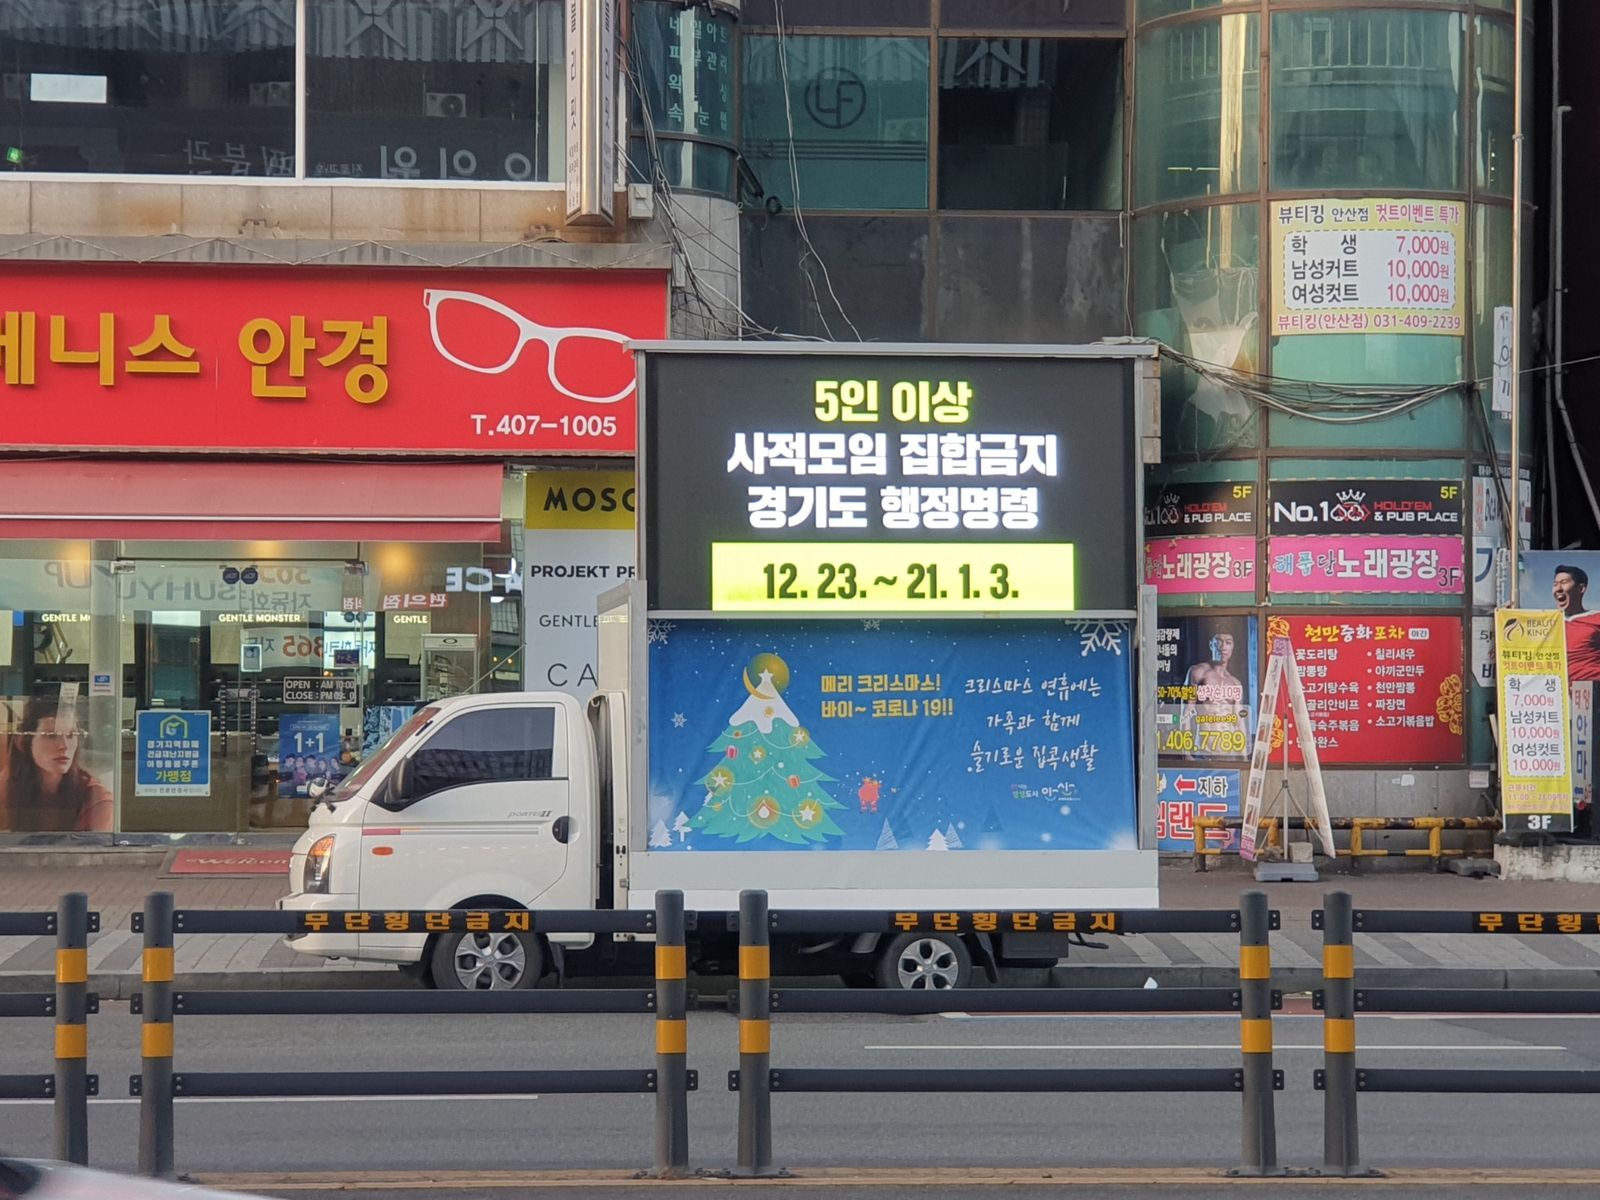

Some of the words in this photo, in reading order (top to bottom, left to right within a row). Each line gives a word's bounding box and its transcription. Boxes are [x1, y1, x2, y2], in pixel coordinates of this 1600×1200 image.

[1279, 204, 1325, 224] 뷰티킹
[1331, 207, 1369, 223] 안산점
[1439, 205, 1460, 225] 특가
[1291, 236, 1308, 256] 학
[1341, 234, 1357, 255] 생
[1396, 236, 1449, 256] 7,000원
[1292, 258, 1359, 279] 남성커트
[1387, 259, 1449, 280] 10,000원
[1387, 284, 1449, 304] 10,000원
[1278, 314, 1369, 330] 뷰티킹(안산점)
[1373, 315, 1461, 330] 031-409-2239
[238, 315, 389, 404] 안경
[815, 380, 879, 422] 5인
[892, 381, 972, 423] 이상
[470, 414, 617, 437] T.407-1005
[727, 431, 887, 475] 사적모임
[899, 432, 1057, 476] 집합금지
[1233, 485, 1252, 499] 5F
[1440, 486, 1457, 499] 5F
[747, 486, 868, 528] 경기도
[880, 485, 1039, 529] 행정명령
[1192, 513, 1213, 523] PUB
[1215, 512, 1251, 522] PLACE
[1386, 511, 1415, 521] PUB
[1417, 511, 1458, 522] PLACE
[531, 565, 609, 578] PROJEKT
[1162, 552, 1231, 579] 노래광장
[1233, 560, 1254, 578] 3F
[1336, 549, 1439, 579] 노래광장
[1438, 567, 1462, 588] 3F
[763, 563, 808, 599] 12.
[817, 563, 867, 599] 23.
[907, 563, 947, 599] 21.
[959, 563, 980, 599] 1.
[990, 563, 1019, 599] 3.
[218, 613, 255, 623] GENTLE
[256, 613, 301, 623] MONSTER
[393, 614, 428, 624] GENTLE
[1375, 648, 1416, 660] 칠리새우
[1502, 650, 1532, 661] 뷰티킹
[1375, 665, 1425, 677] 야끼군만두
[286, 680, 311, 689] OPEN
[857, 673, 941, 693] 크리스마스!
[965, 677, 1033, 694] 크리스마스
[1041, 672, 1101, 701] 연휴에는
[1375, 682, 1416, 694] 천만짬뽕
[1509, 678, 1521, 692] 학
[1544, 678, 1557, 692] 생
[286, 691, 313, 700] CLOSE
[872, 699, 919, 717] 코로나
[922, 698, 953, 716] 19!!
[1306, 699, 1360, 711] 골리안비프
[1375, 699, 1406, 710] 짜장면
[987, 710, 1035, 735] 가족과
[1042, 709, 1081, 732] 함께
[1375, 716, 1435, 728] 소고기볶음밥
[1510, 710, 1560, 725] 남성커트
[294, 732, 325, 753] 1+1
[971, 740, 1025, 773] 슬기로운
[1032, 740, 1099, 772] 집콕생활
[155, 770, 192, 783] 가맹점
[1199, 775, 1228, 798] 지하
[1527, 814, 1552, 830] 3F
